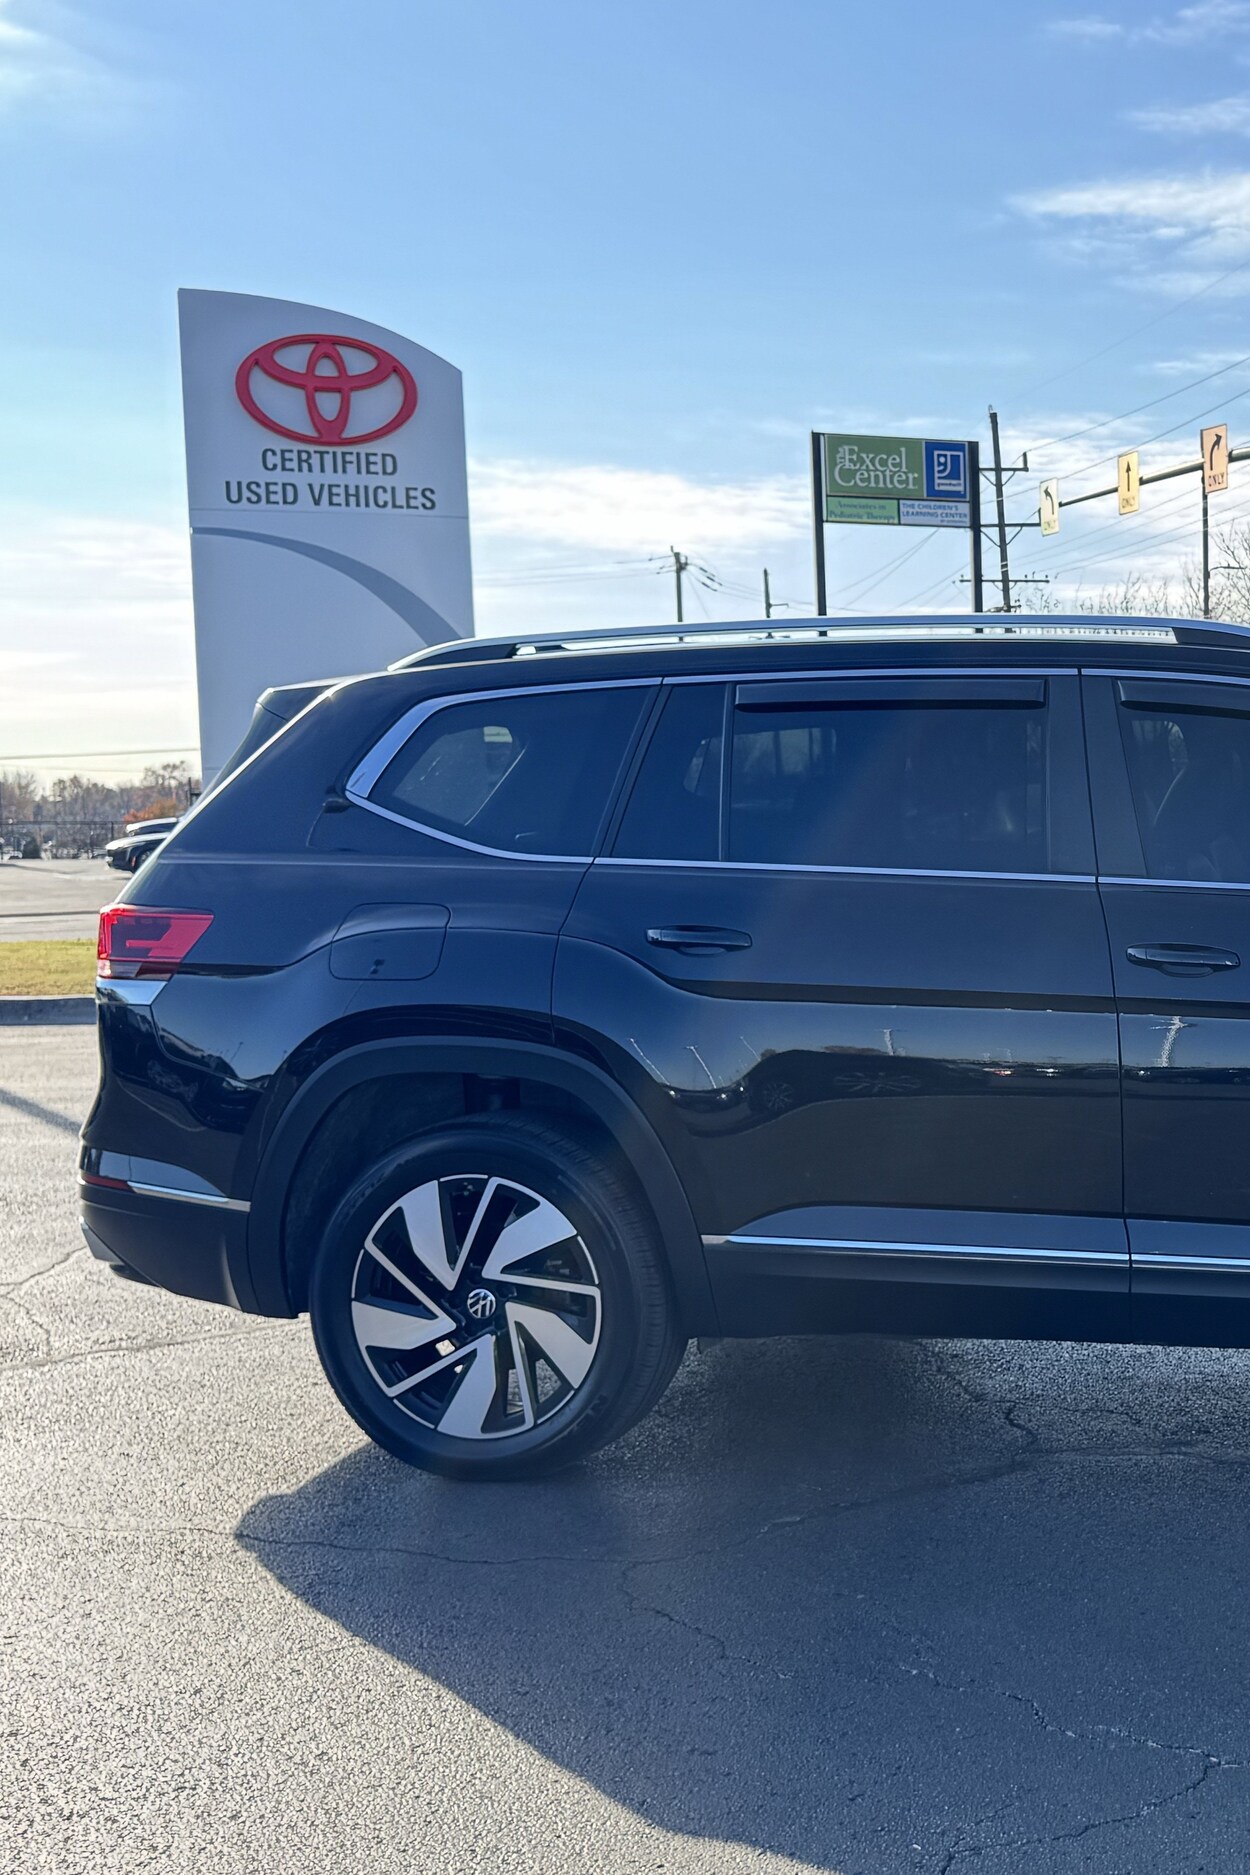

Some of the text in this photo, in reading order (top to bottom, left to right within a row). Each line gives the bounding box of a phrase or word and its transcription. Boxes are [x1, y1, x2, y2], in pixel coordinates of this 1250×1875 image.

[261, 447, 398, 477] CERTIFIED
[843, 445, 908, 472] Excel
[834, 462, 919, 490] Center
[1207, 471, 1225, 487] ONLY
[225, 480, 437, 511] USED VEHICLES
[902, 502, 959, 511] THE CHILDREN'S
[902, 511, 939, 519] LEARNING
